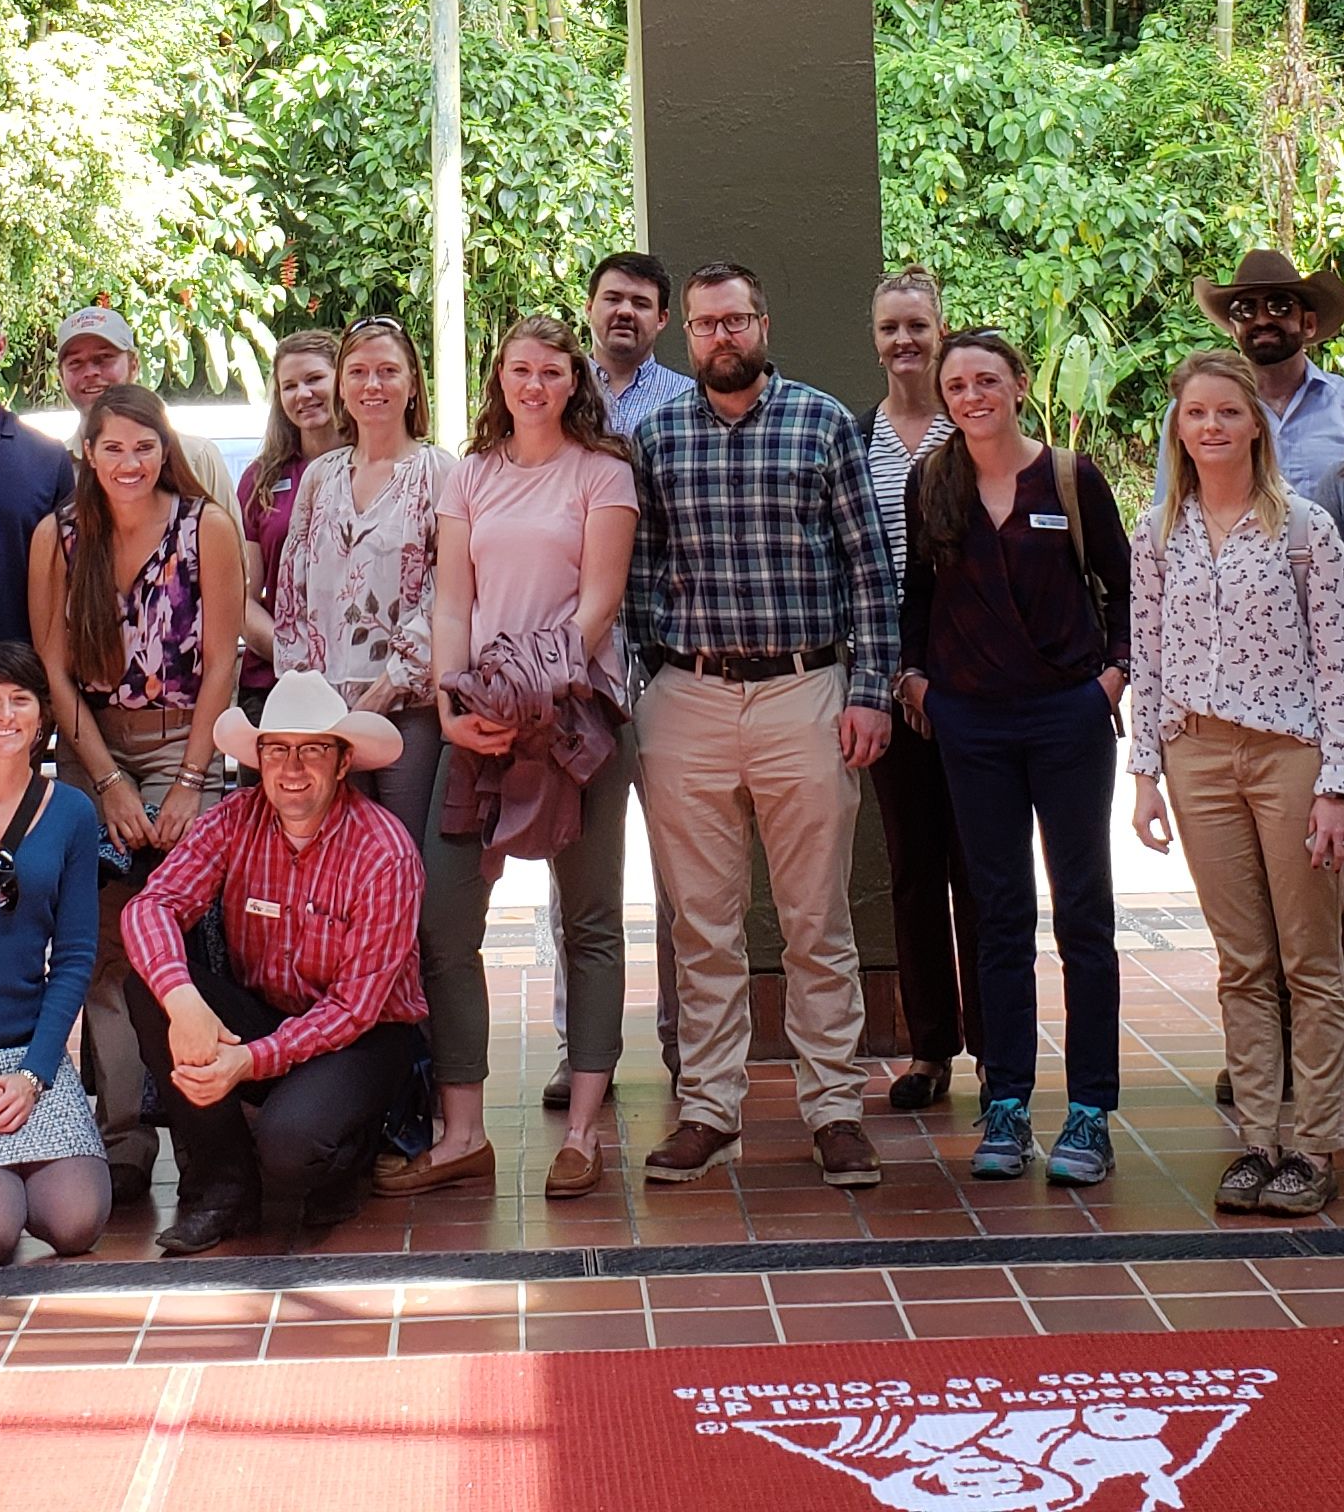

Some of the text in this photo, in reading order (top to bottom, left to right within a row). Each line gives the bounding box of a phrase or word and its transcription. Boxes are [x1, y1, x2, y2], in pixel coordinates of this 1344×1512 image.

[672, 1368, 1279, 1402] Cafeteros de Colombia
[695, 1400, 753, 1417] de
[771, 1392, 982, 1415] Nacional
